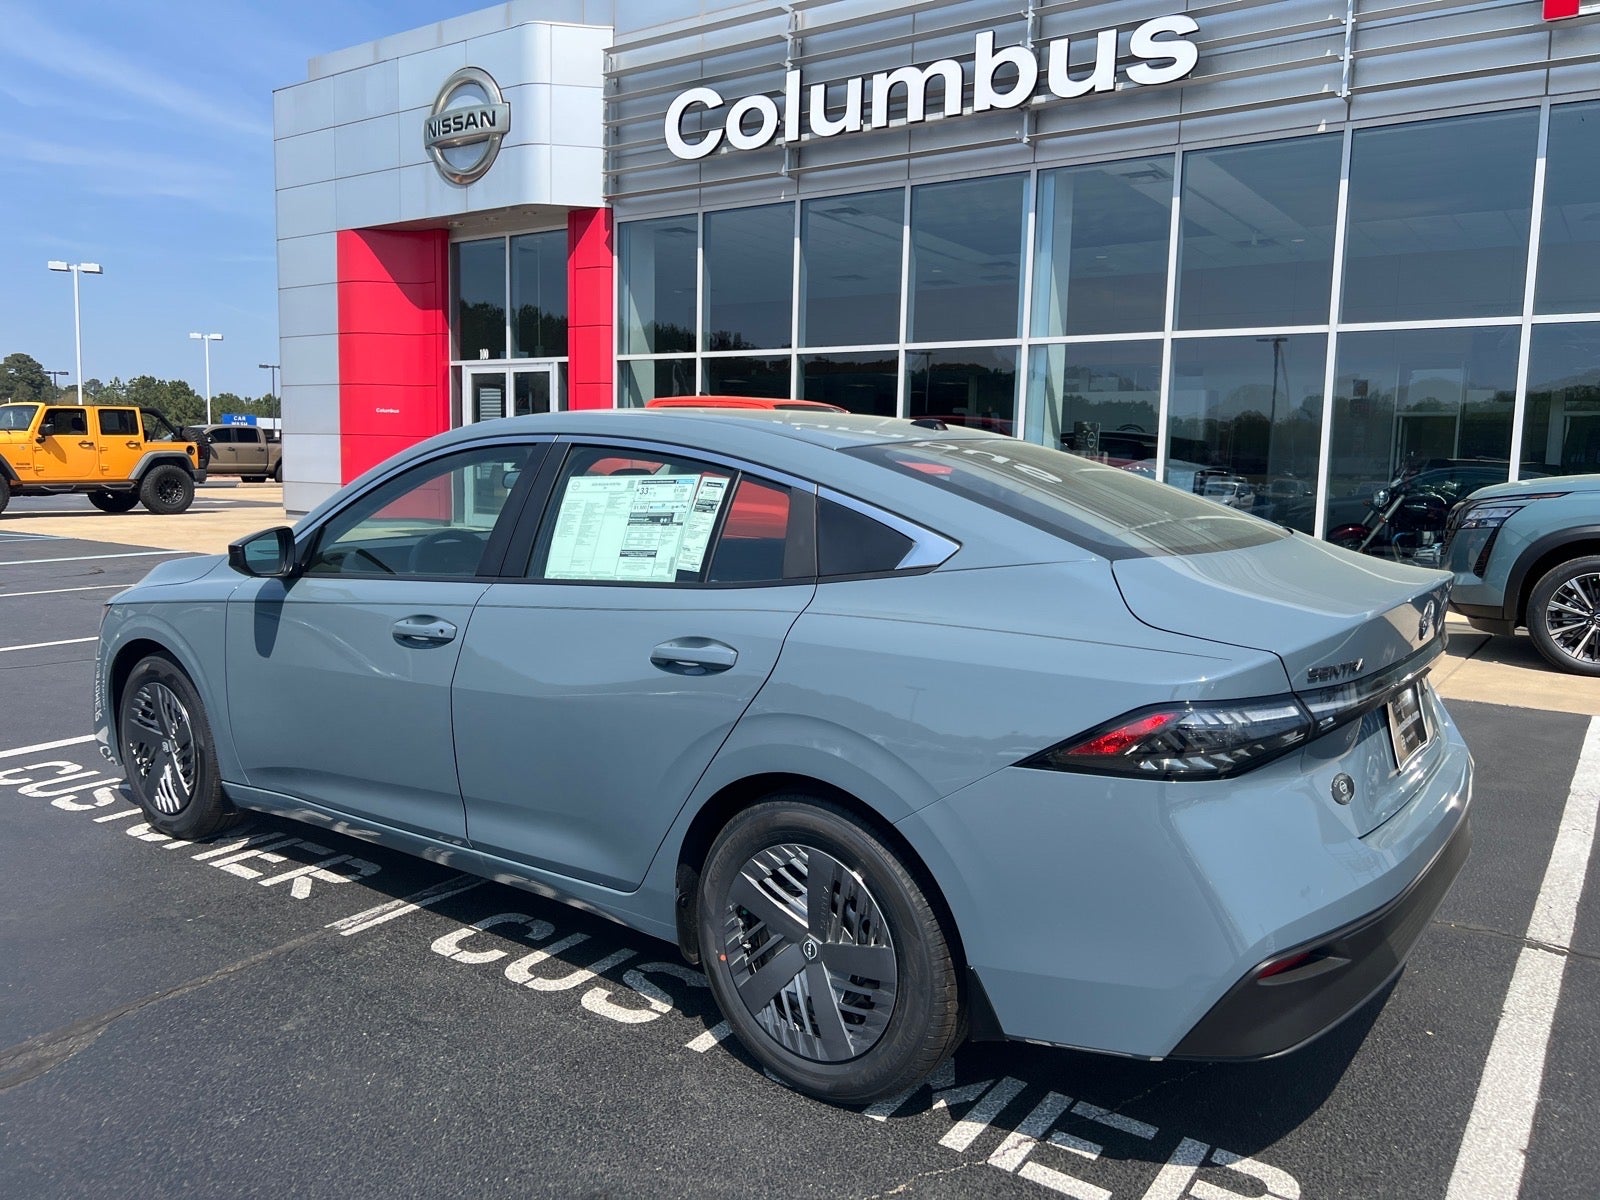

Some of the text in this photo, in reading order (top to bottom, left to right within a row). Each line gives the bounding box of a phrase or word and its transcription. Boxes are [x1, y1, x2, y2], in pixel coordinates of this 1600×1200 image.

[427, 110, 496, 138] NISSAN
[665, 14, 1200, 160] Columbus
[0, 760, 382, 900] CUSMER
[430, 912, 1301, 1200] CUSMER
